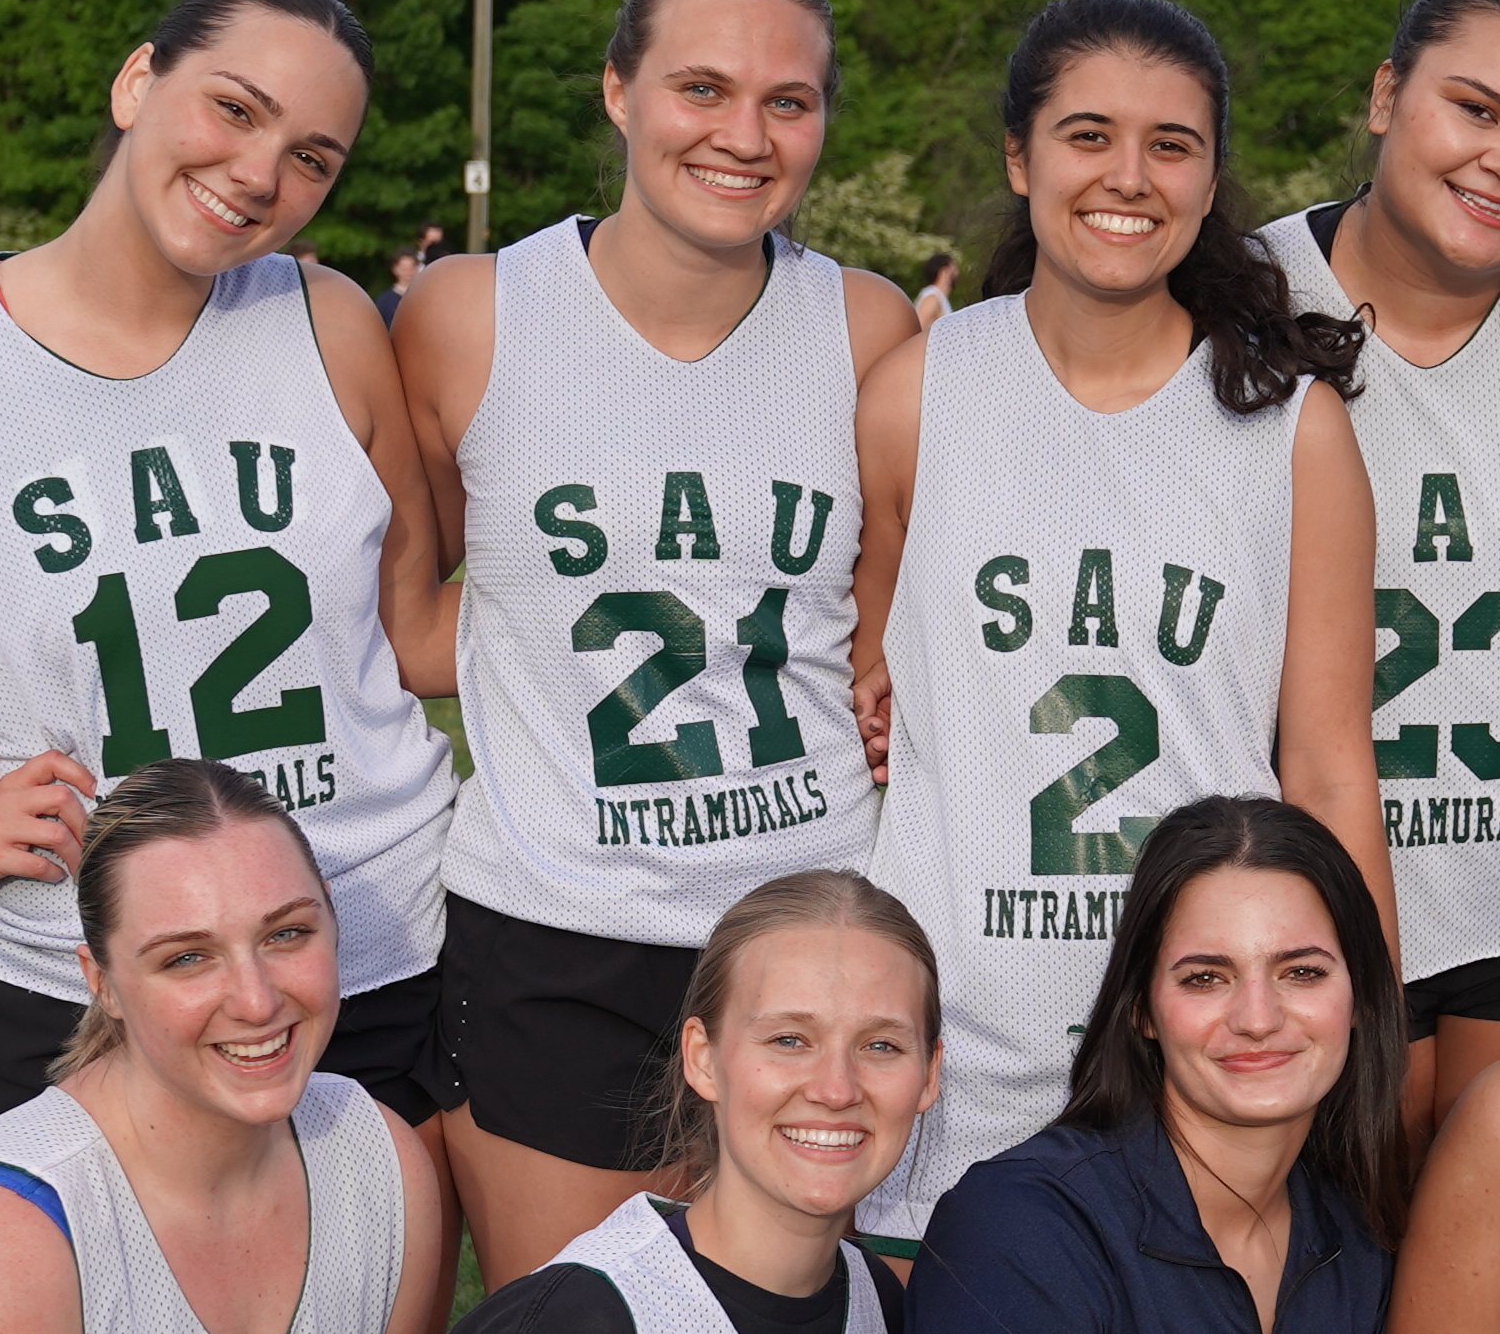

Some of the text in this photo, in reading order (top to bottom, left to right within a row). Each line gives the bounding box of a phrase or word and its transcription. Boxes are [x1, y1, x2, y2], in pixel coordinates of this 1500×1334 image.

[12, 441, 295, 573] SAU
[534, 471, 834, 577] SAU
[72, 546, 327, 778] 12
[975, 548, 1226, 666] SAU
[571, 586, 807, 788] 21
[595, 769, 829, 848] INTRAMURALS
[1029, 674, 1161, 876] 2
[984, 888, 1132, 940] INTRAMU
